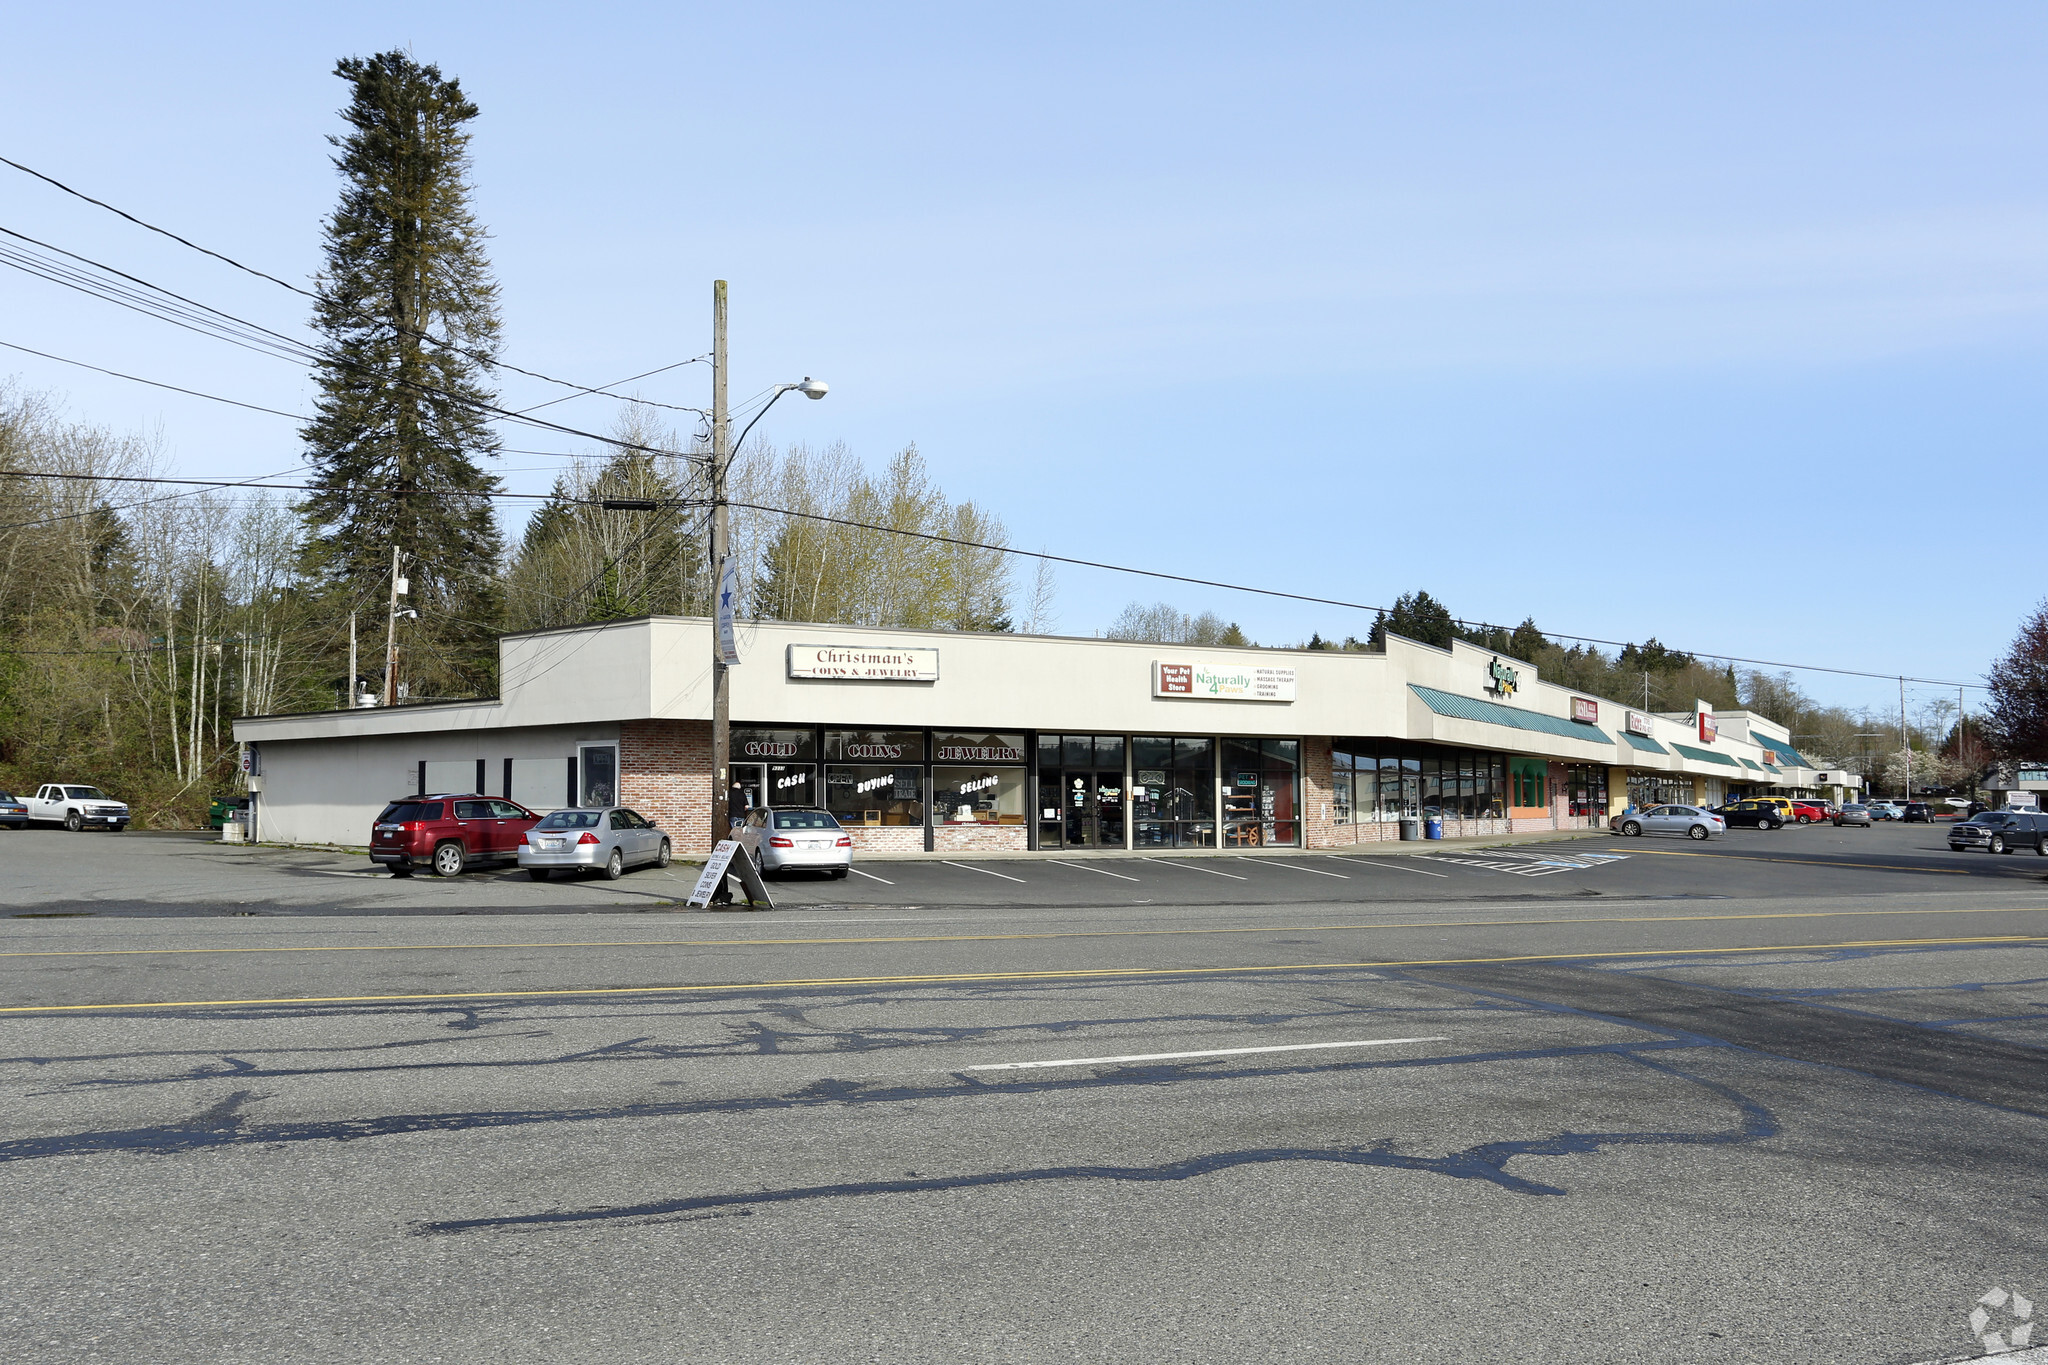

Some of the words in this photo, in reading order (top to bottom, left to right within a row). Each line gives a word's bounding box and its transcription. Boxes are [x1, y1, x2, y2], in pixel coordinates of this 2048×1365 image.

[817, 649, 914, 665] Christman's
[812, 667, 847, 676] COINS
[851, 668, 859, 676] &
[865, 668, 919, 677] JEWELRY
[1162, 666, 1178, 675] Your
[1179, 667, 1190, 675] Pet
[1166, 675, 1188, 683] Health
[1196, 673, 1250, 689] Naturally
[1168, 683, 1186, 691] Store
[1209, 681, 1219, 695] 4
[1220, 685, 1244, 693] Paws
[745, 741, 797, 756] GOLD
[847, 743, 901, 759] COINS
[938, 745, 1021, 761] JEWELRY
[777, 772, 806, 789] CASH
[857, 773, 894, 794] BUYING
[894, 779, 916, 789] SELL
[959, 775, 999, 795] SELLING
[894, 789, 917, 799] TRADE
[715, 843, 731, 852] CASH
[710, 862, 721, 870] GOLD
[704, 871, 717, 879] SILVER
[700, 880, 712, 889] COINS
